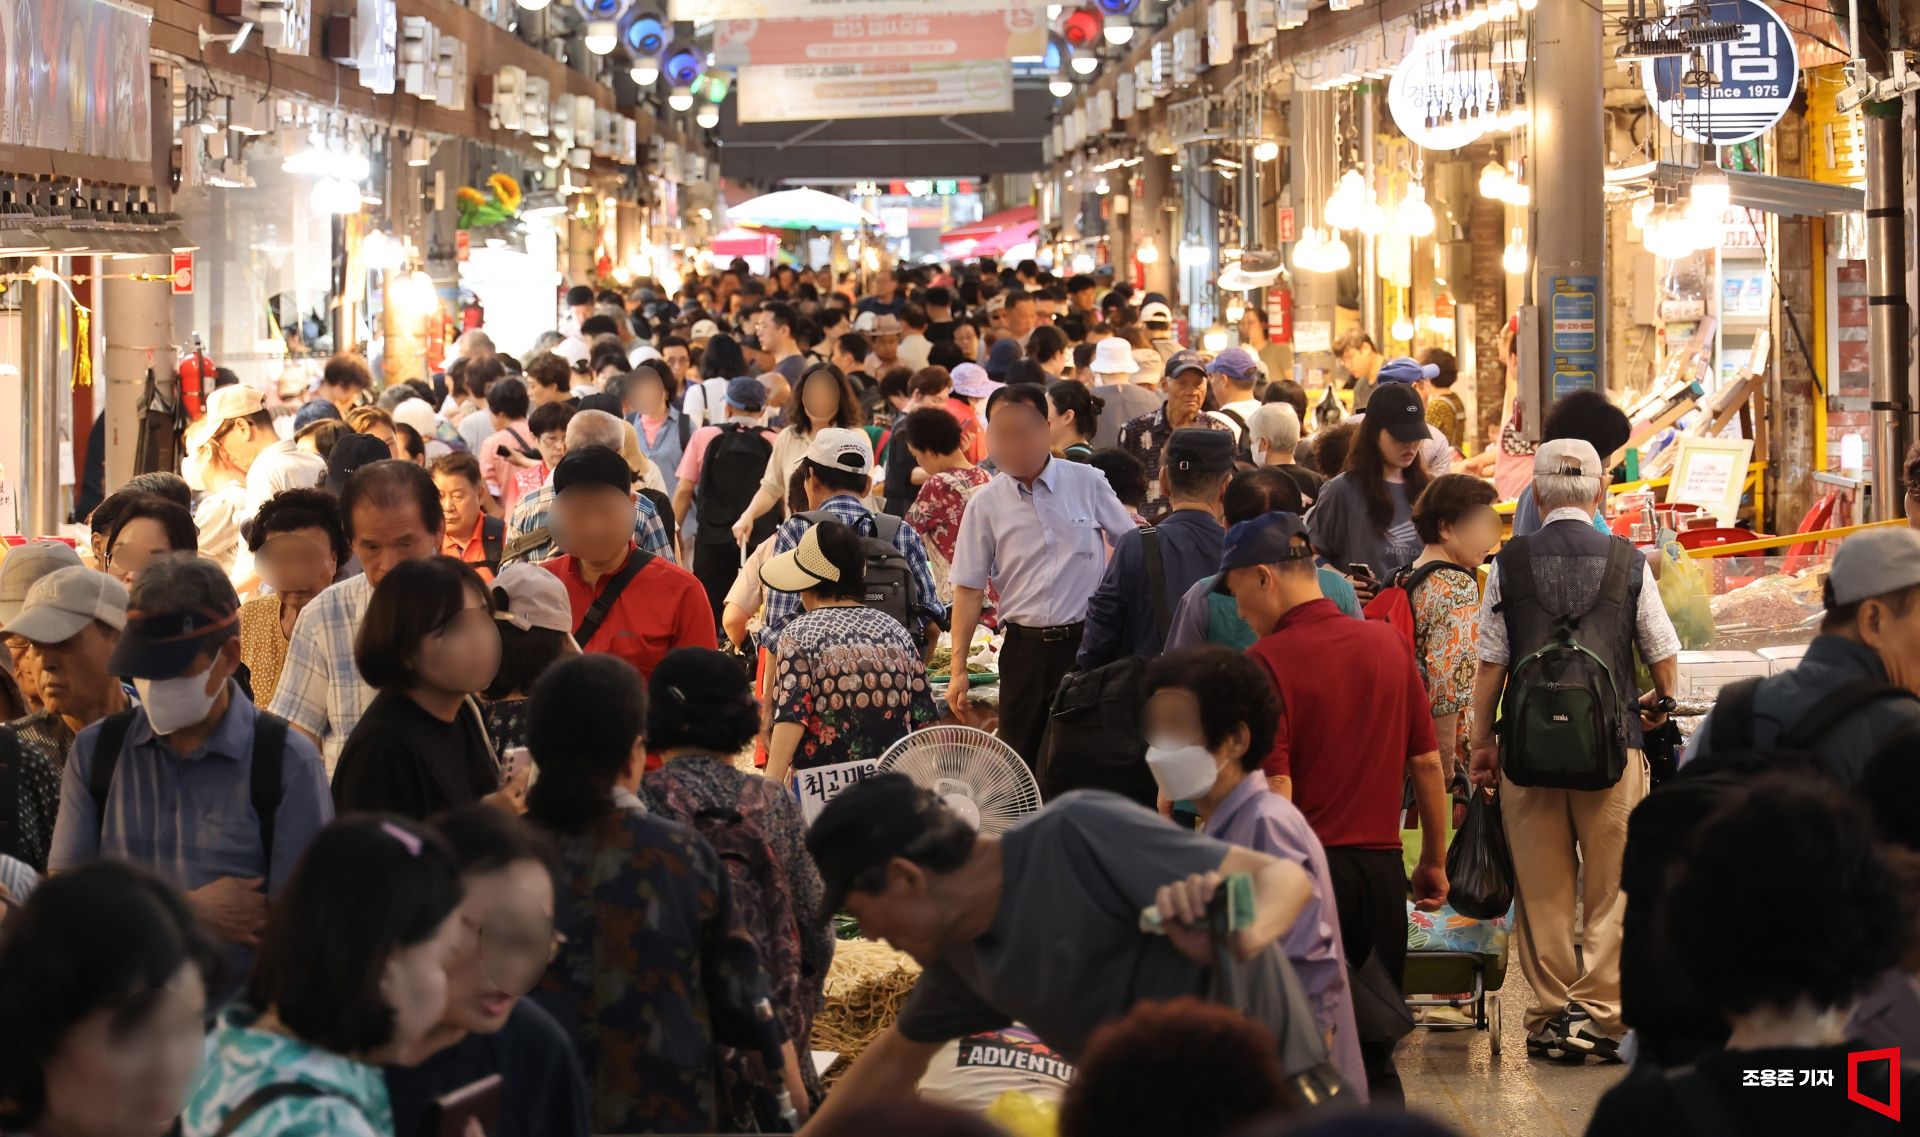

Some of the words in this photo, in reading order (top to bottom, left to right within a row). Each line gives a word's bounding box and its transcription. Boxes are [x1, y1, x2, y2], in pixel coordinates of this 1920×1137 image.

[1701, 87, 1742, 98] Since
[1748, 85, 1780, 97] 1975
[1384, 546, 1420, 556] HOND
[805, 769, 840, 801] 최고
